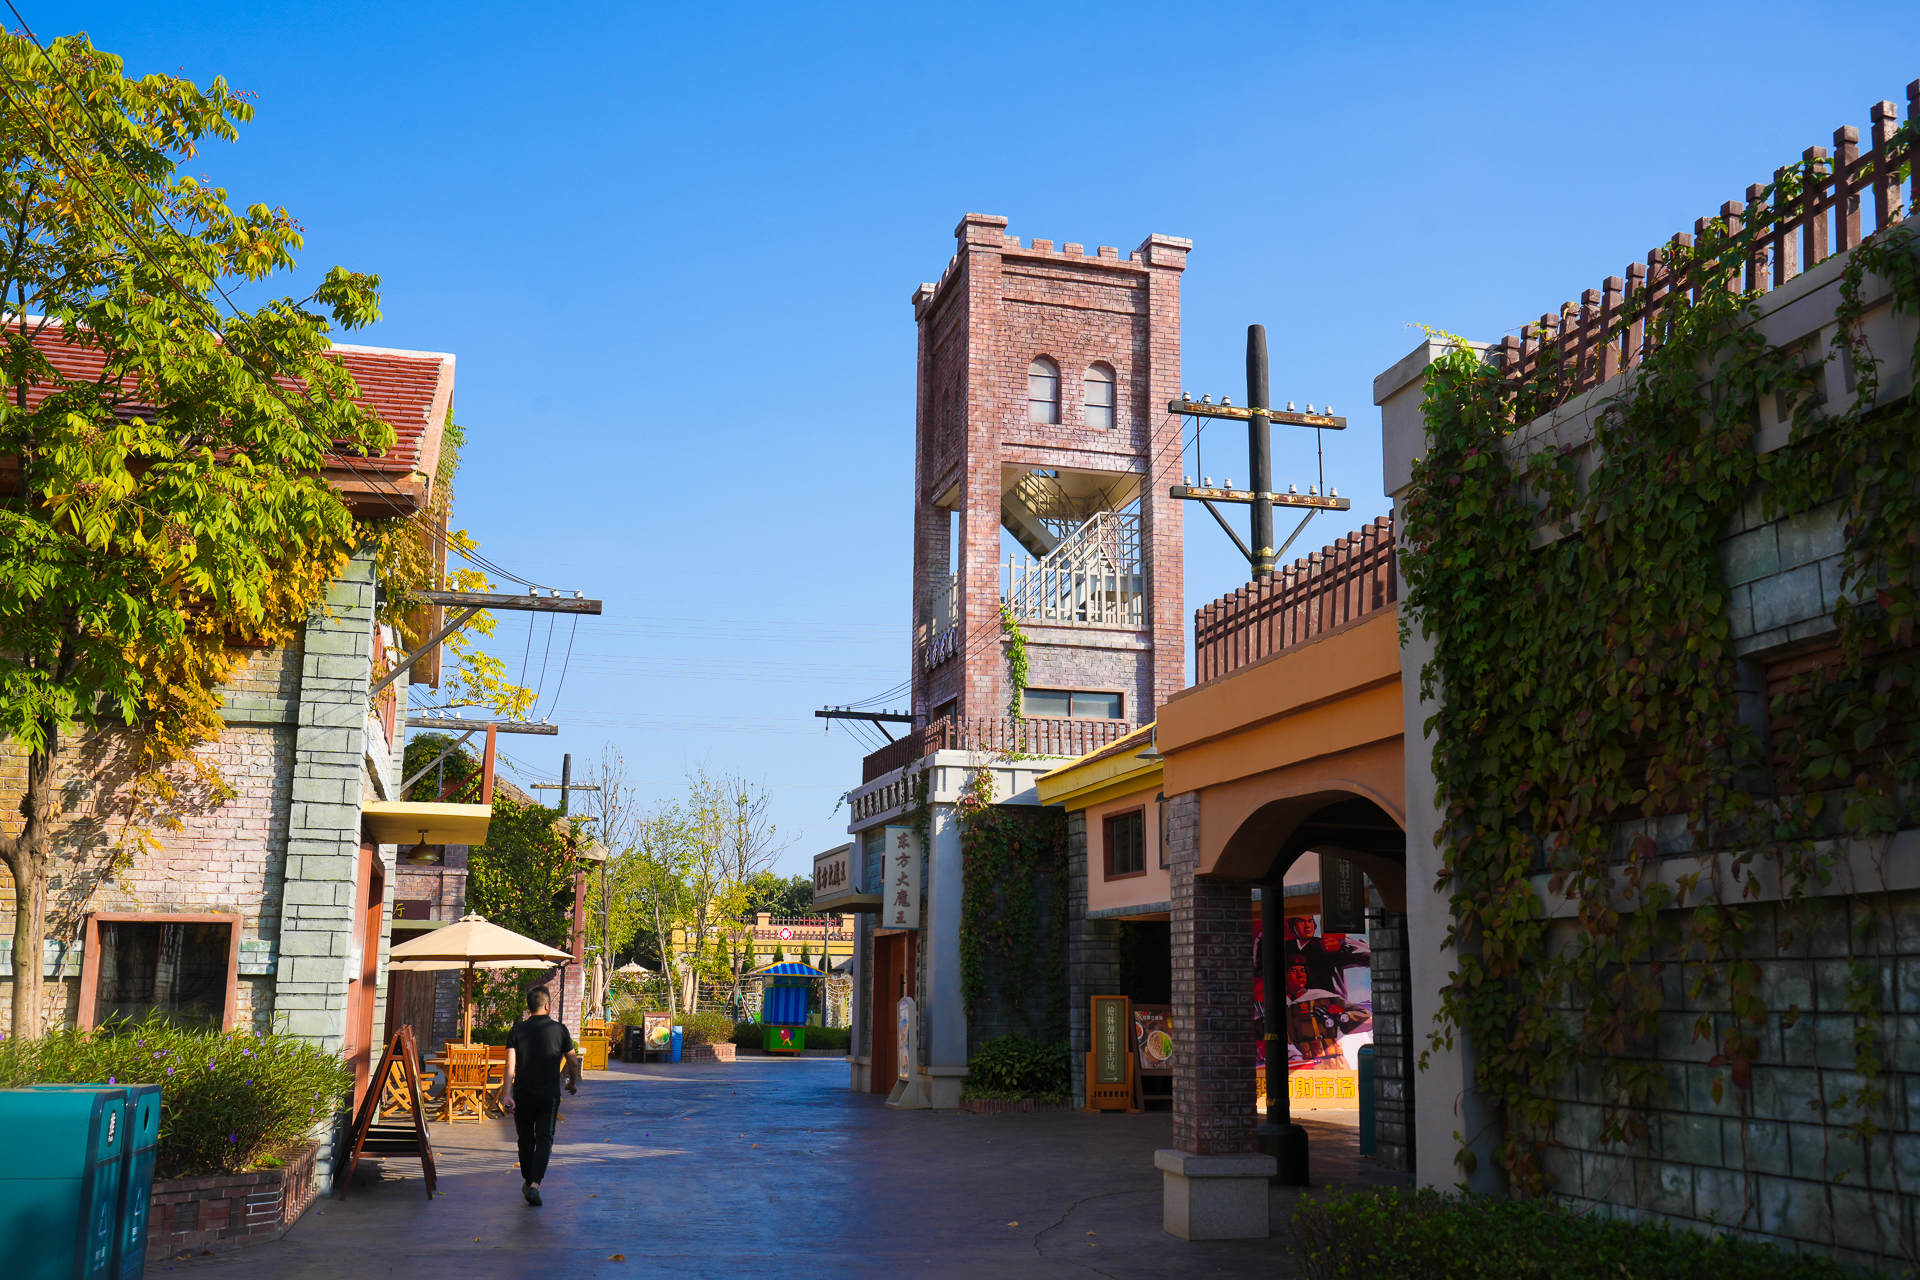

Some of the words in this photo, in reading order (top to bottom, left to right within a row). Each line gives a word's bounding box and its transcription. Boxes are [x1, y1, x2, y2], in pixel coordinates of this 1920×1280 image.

[816, 861, 846, 890] 东方大魔王
[894, 831, 910, 924] 东方大魔王
[1338, 858, 1351, 911] 射击场
[392, 903, 405, 917] 厅
[1107, 1006, 1115, 1070] 枪林弹雨射击场
